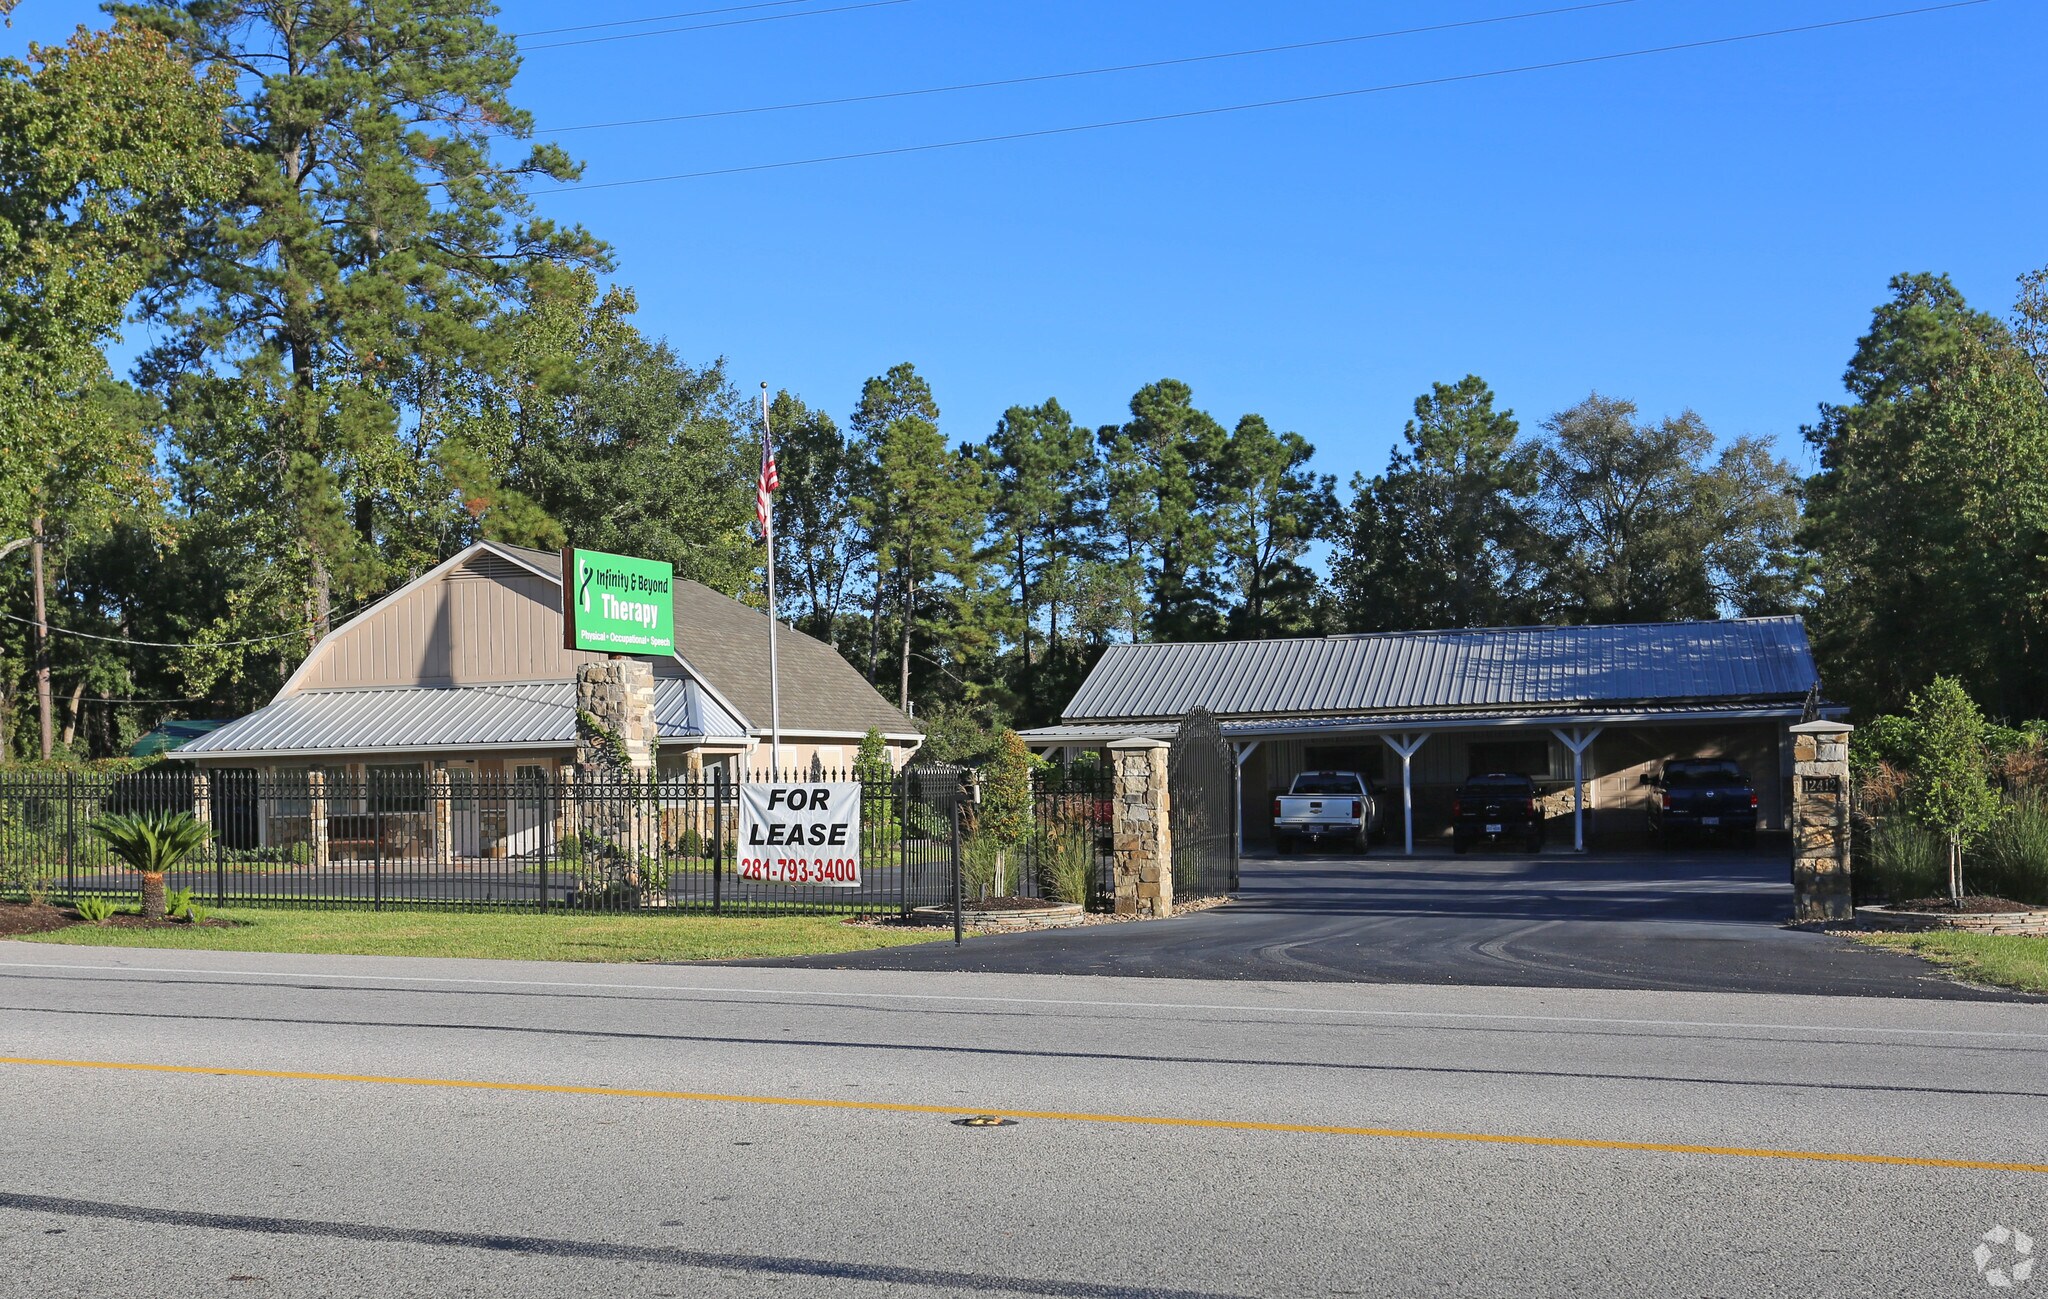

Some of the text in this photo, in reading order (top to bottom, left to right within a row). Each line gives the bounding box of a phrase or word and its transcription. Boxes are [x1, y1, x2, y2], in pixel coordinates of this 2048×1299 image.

[596, 569, 668, 595] Infinity & Beyond
[601, 593, 658, 629] Therapy
[581, 630, 671, 647] Physical Occupational Speech
[1804, 778, 1836, 792] 12412
[767, 788, 830, 811] FOR
[749, 823, 848, 846] LEASE
[741, 858, 856, 882] 281-793-3400
